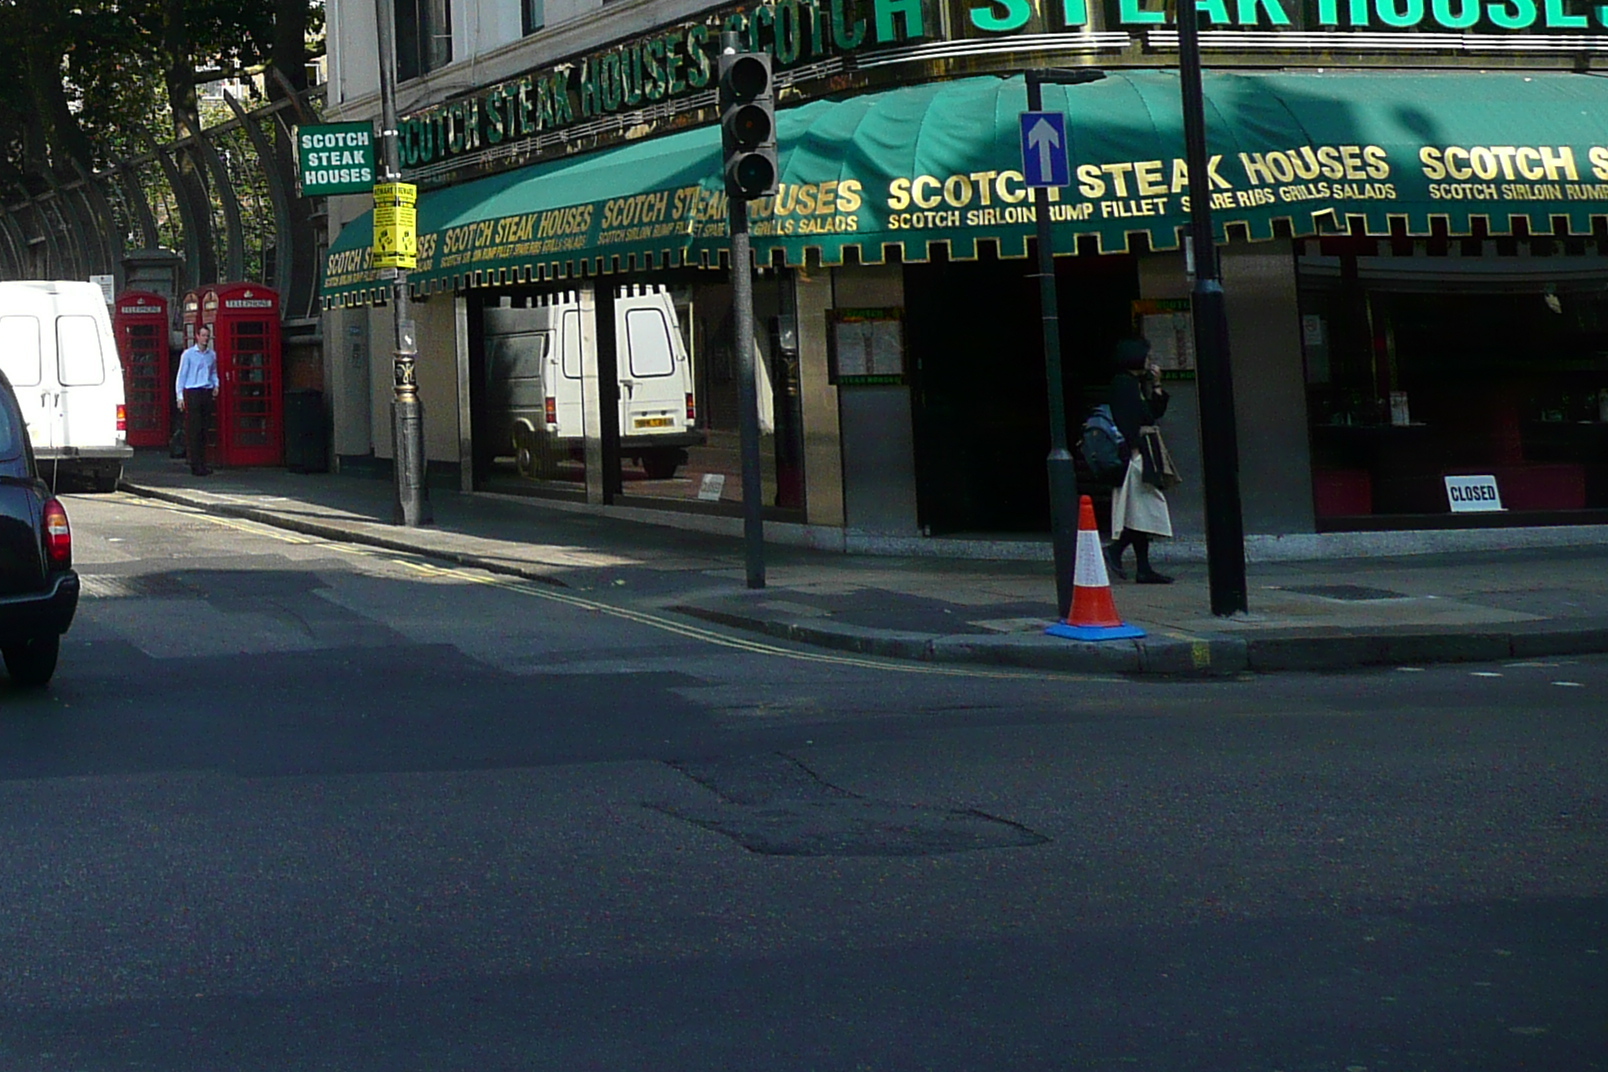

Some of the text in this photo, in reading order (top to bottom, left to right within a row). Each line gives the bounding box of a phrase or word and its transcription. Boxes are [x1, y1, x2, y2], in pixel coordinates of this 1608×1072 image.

[486, 63, 574, 143] STEAK
[581, 23, 711, 117] HOUSES
[301, 131, 369, 149] SCOTCH
[308, 150, 366, 167] STEAK
[1419, 145, 1579, 181] SCOTCH
[304, 167, 372, 185] HOUSES
[1076, 154, 1233, 198] STEAK
[1238, 144, 1390, 186] HOUSES
[1429, 183, 1498, 200] SCOTCH
[1501, 183, 1563, 200] SIRLOIN
[601, 190, 669, 228] SCOTCH
[888, 210, 960, 229] SCOTCH
[966, 206, 1037, 226] SIRLOIN
[1101, 197, 1168, 218] FILLET
[1235, 187, 1276, 208] RIBS
[1279, 182, 1332, 202] GRILLS
[1332, 182, 1397, 200] SALADS
[443, 204, 594, 255] SCOTCH STEAK HOUSES
[798, 215, 859, 234] SALADS
[326, 248, 363, 277] SCOTCH
[226, 299, 272, 308] TELEPHONE
[1449, 485, 1497, 503] CLOSED
